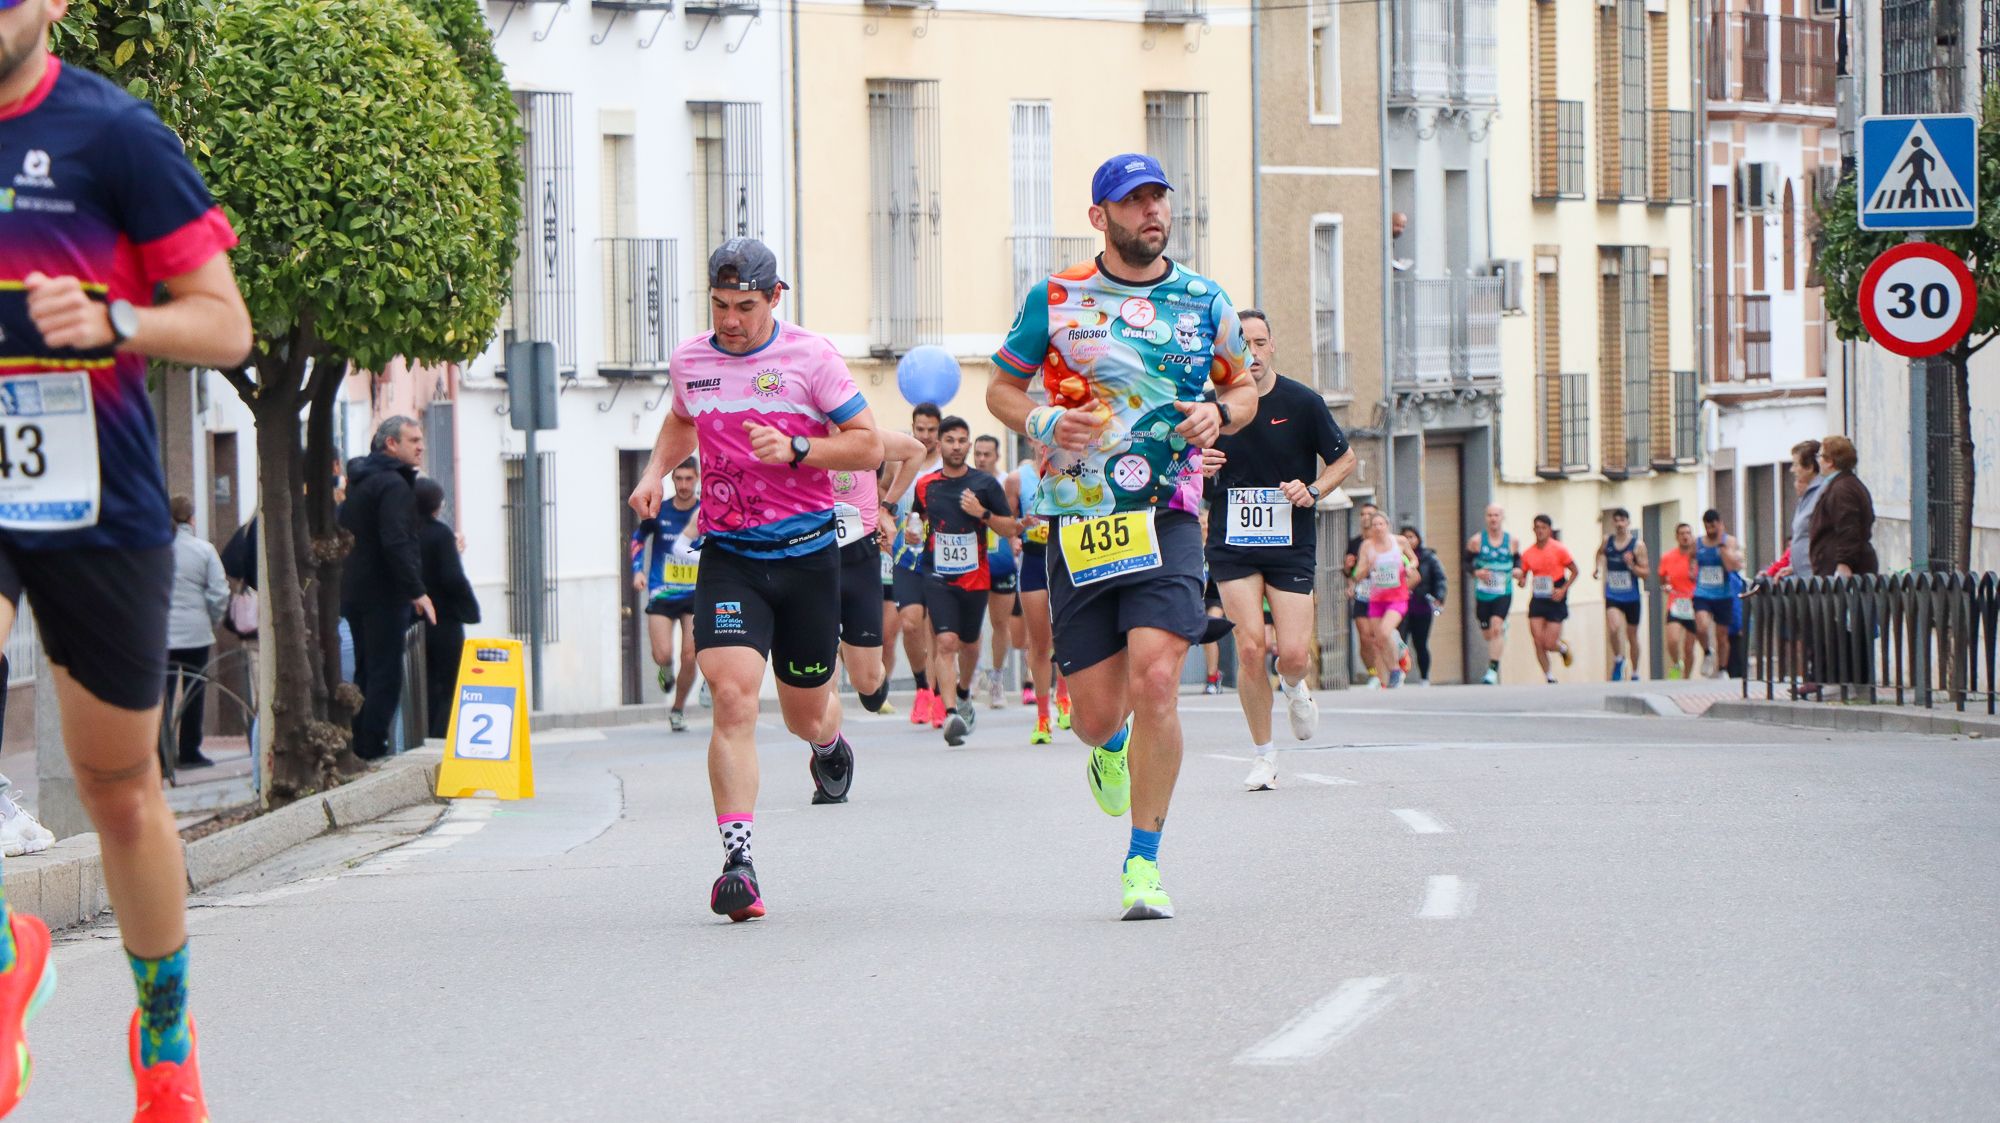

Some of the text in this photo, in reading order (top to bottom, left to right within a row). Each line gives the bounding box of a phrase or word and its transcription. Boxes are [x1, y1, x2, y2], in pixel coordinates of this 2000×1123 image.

[1886, 282, 1950, 319] 30
[1240, 506, 1273, 528] 901
[1080, 516, 1130, 554] 435
[943, 546, 968, 561] 943
[672, 565, 692, 579] 311
[463, 689, 483, 701] km
[470, 713, 494, 744] 2
